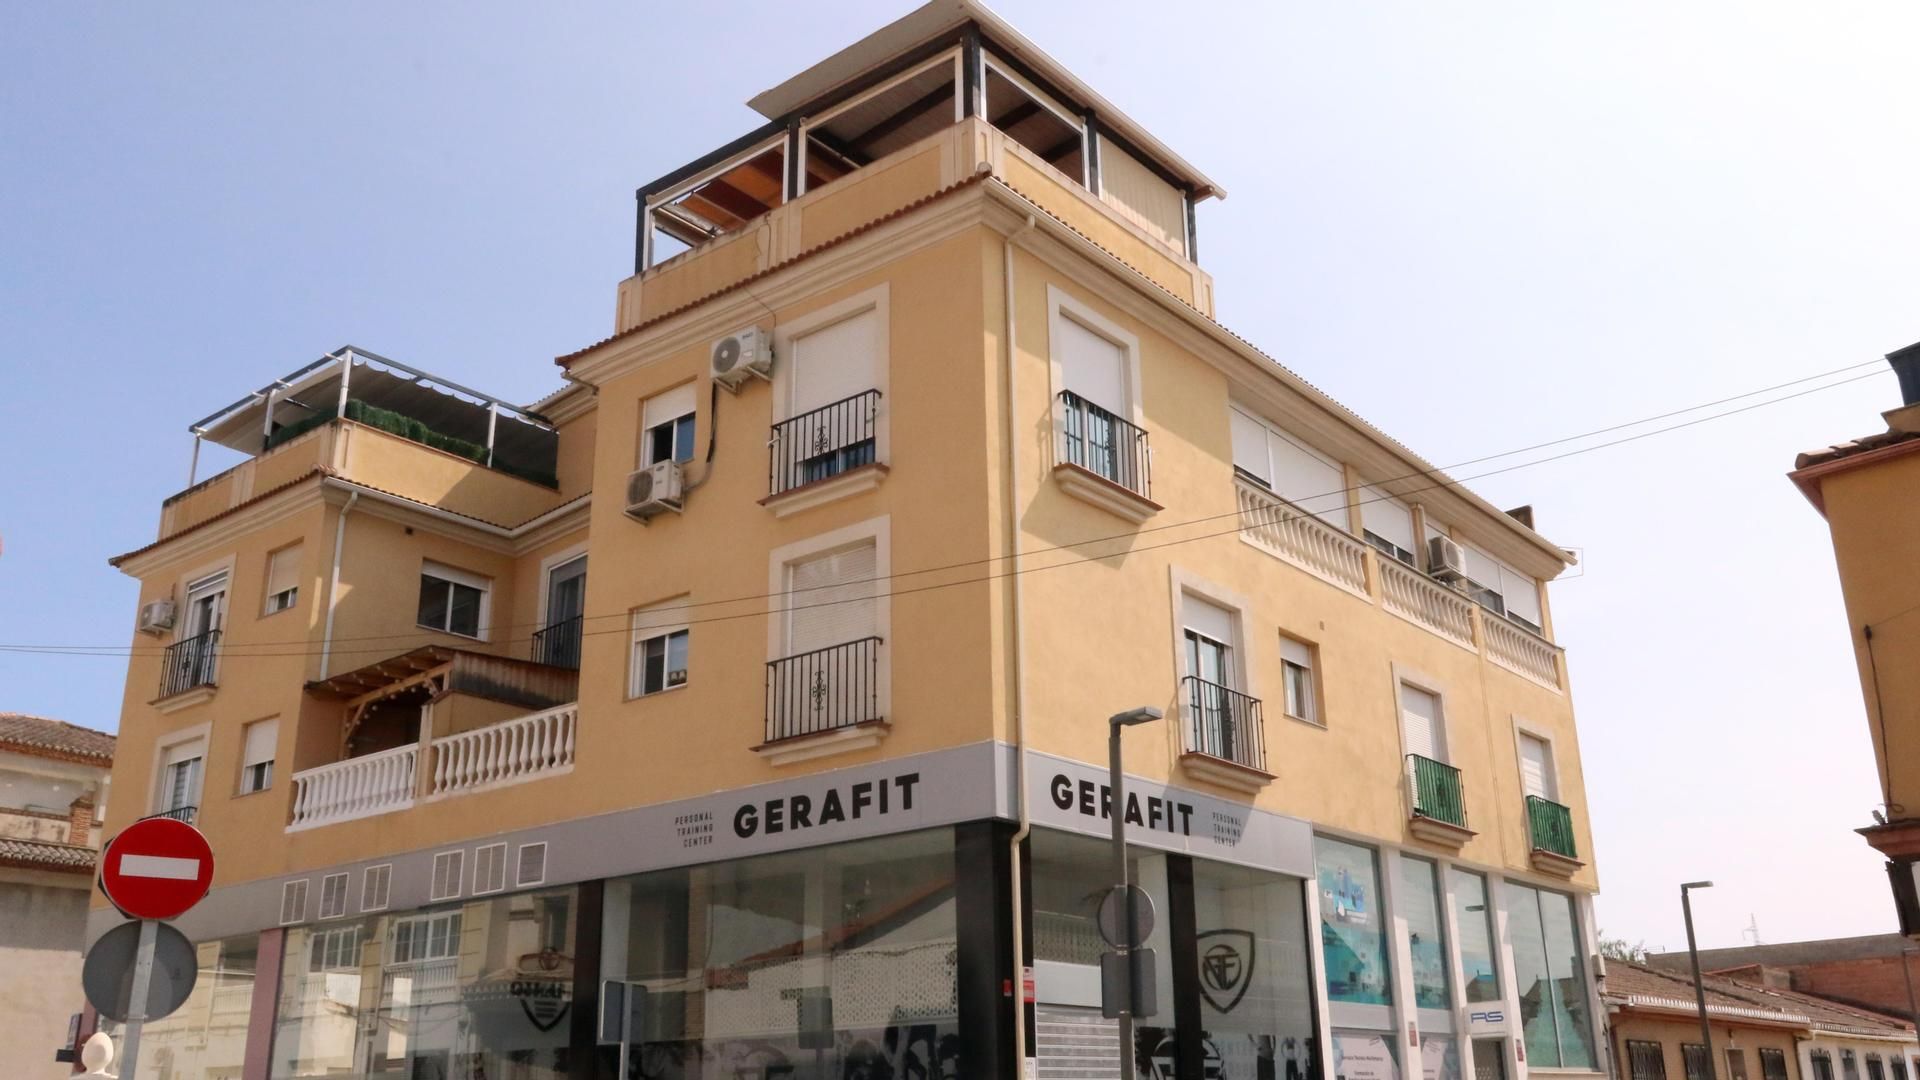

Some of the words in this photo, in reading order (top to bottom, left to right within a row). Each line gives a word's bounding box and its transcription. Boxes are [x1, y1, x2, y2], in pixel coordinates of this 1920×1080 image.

[733, 772, 920, 839] GERAFIT
[674, 811, 713, 825] PERSONAL
[1212, 811, 1242, 826] PERSONAL
[677, 823, 713, 837] TRAINING
[1213, 823, 1242, 838] TRAINING
[683, 835, 713, 848] CENTER
[1213, 835, 1236, 848] CENTER
